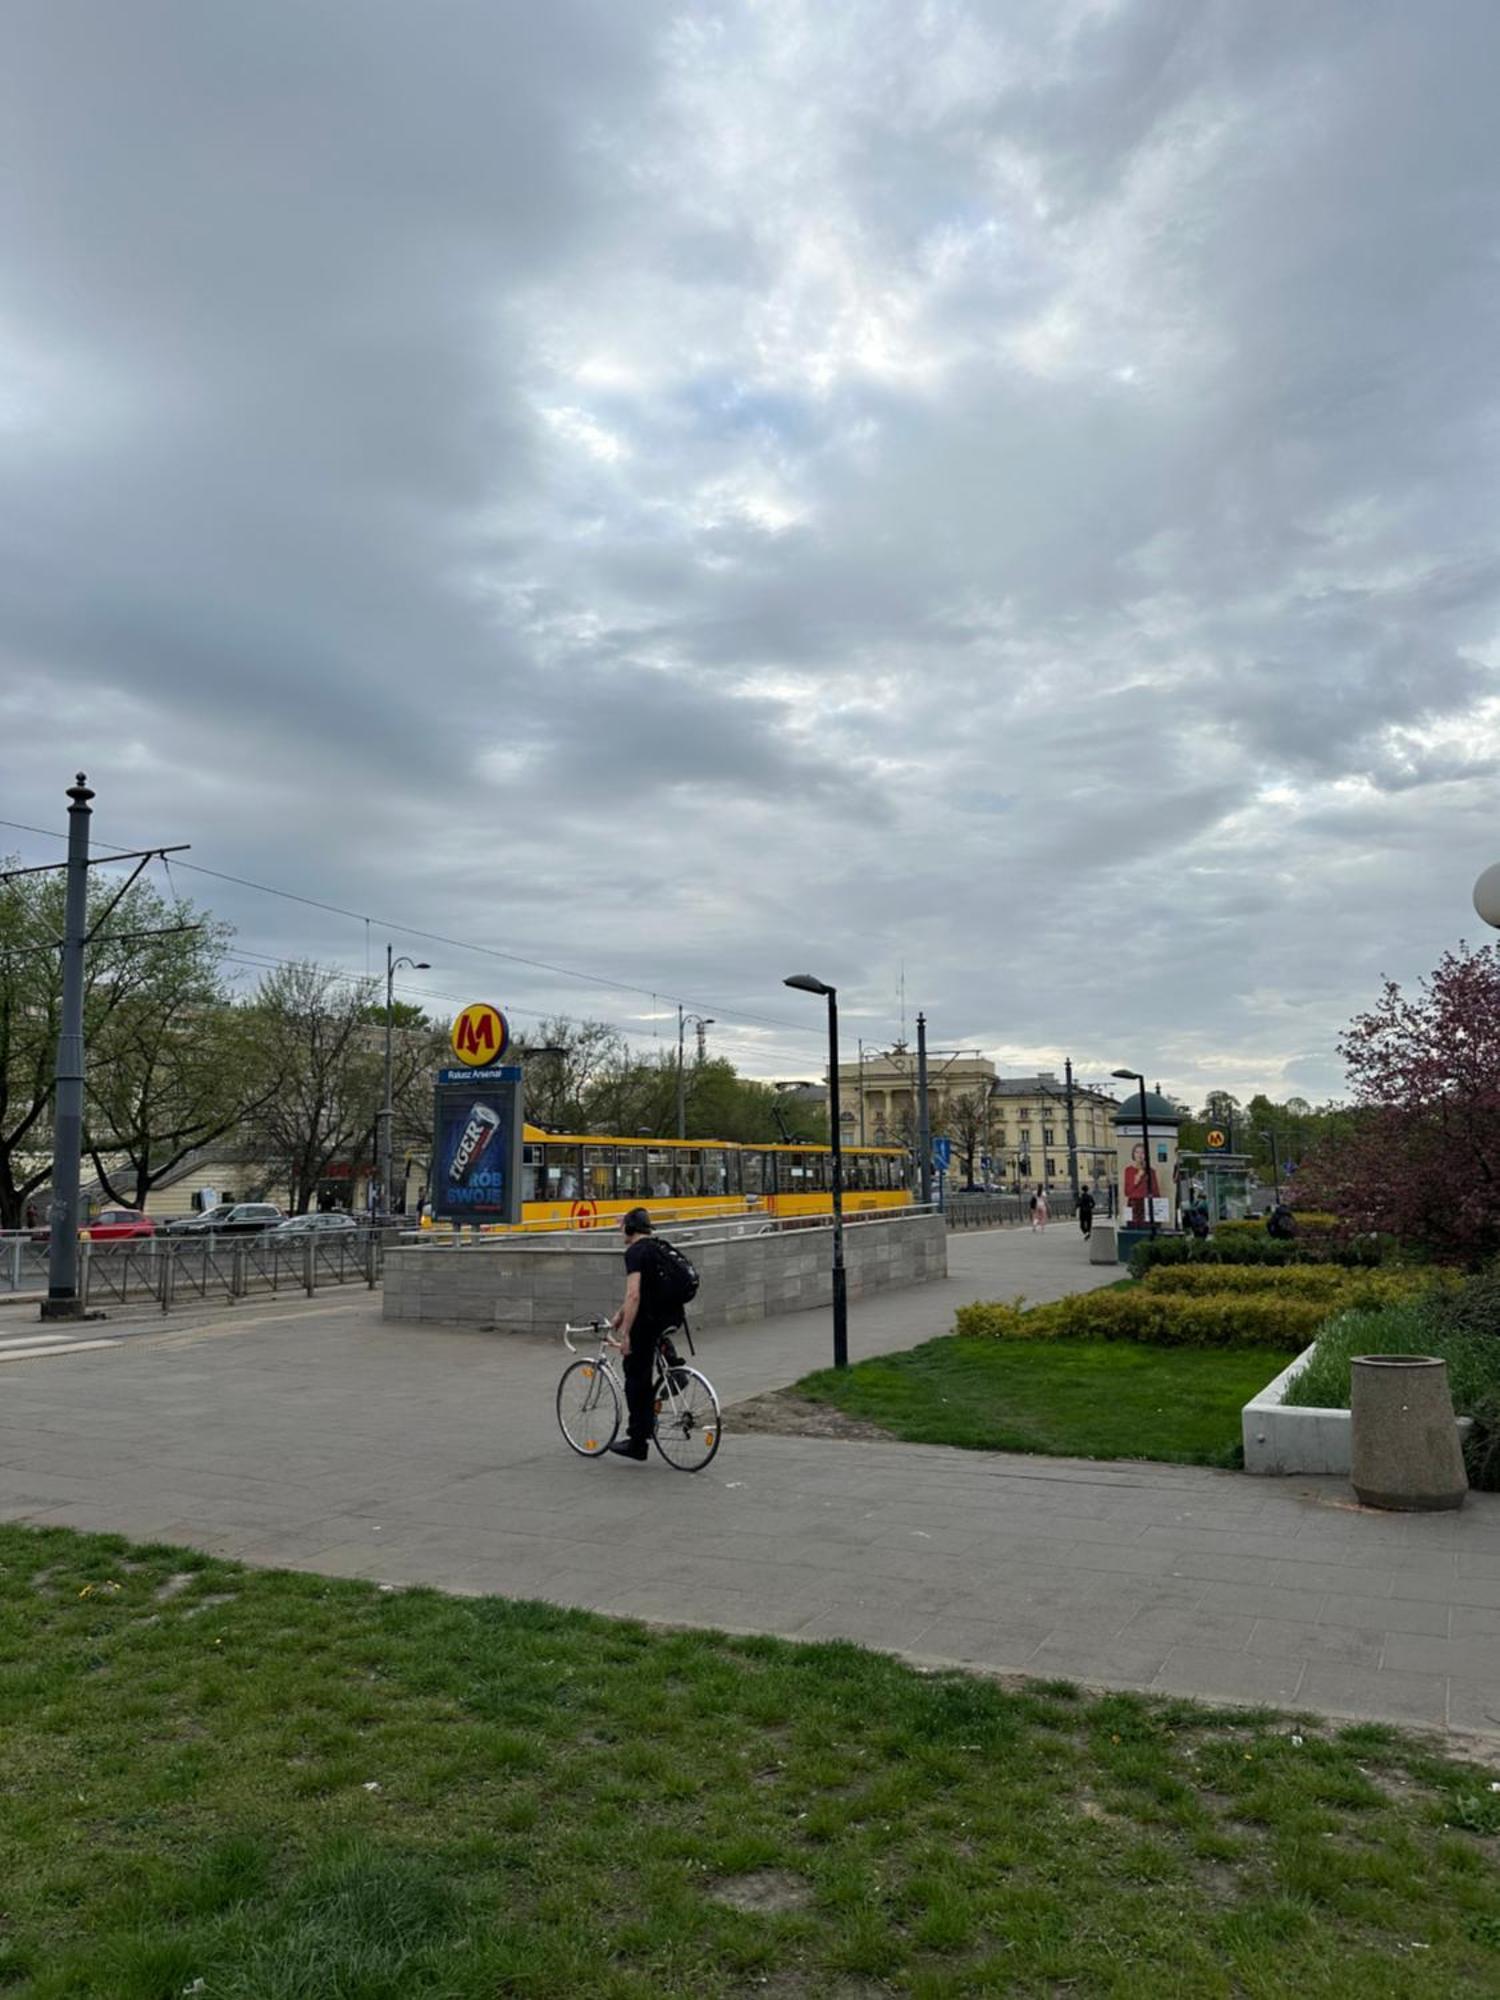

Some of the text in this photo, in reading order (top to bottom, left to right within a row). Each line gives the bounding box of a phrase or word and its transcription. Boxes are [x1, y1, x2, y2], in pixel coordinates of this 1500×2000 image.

[456, 1014, 495, 1056] M
[472, 1070, 502, 1078] Arsenal
[449, 1120, 484, 1181] TIGER
[447, 1187, 502, 1204] SWOJE
